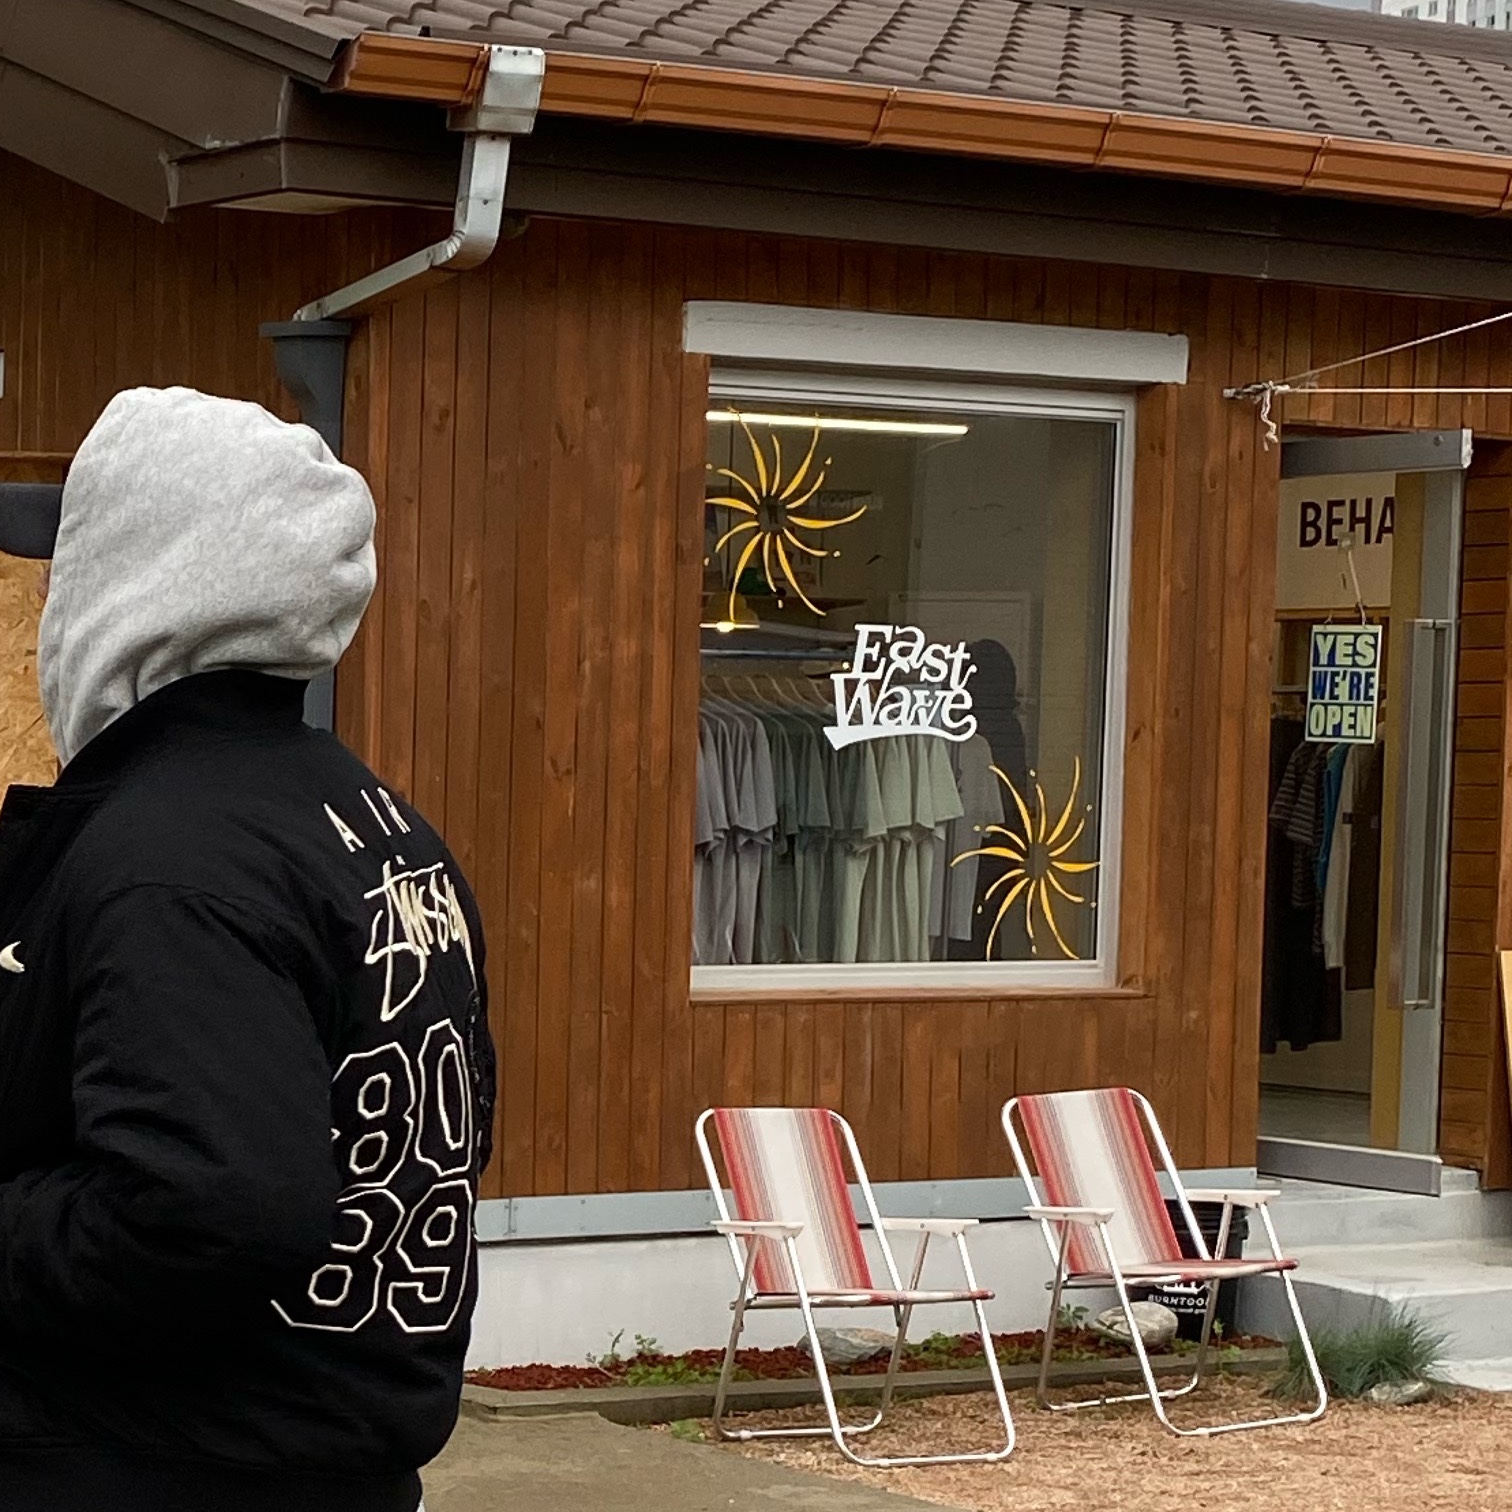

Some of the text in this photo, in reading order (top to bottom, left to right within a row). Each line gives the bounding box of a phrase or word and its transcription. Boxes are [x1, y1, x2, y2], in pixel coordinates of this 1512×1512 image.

[851, 623, 977, 690] East
[1313, 634, 1376, 667] YES
[823, 661, 977, 750] Wave
[1311, 669, 1376, 702] WE'RE
[1309, 704, 1374, 737] OPEN
[323, 786, 412, 853] AIR
